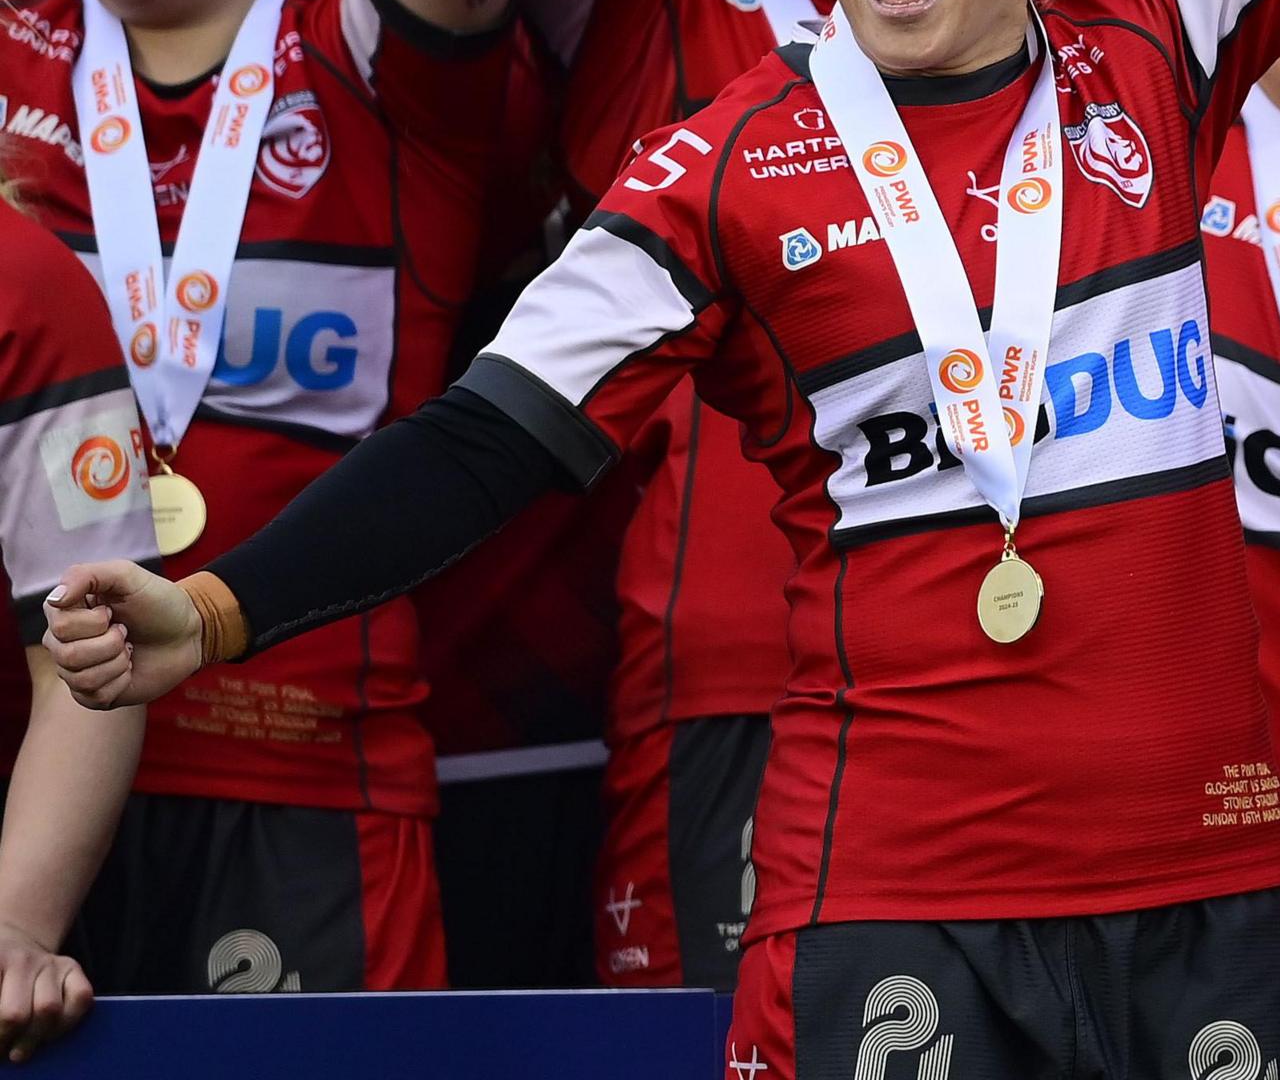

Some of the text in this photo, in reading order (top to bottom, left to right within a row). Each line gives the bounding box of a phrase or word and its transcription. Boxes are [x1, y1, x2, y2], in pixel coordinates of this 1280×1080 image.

[743, 136, 843, 164] HARTP
[1022, 128, 1039, 174] PWR
[750, 152, 850, 180] UNIVER
[890, 180, 920, 224] PWR
[999, 345, 1023, 400] PWR
[963, 399, 989, 453] PWR
[1223, 764, 1241, 778] THE
[1205, 780, 1249, 795] GLOS-HART
[1223, 796, 1254, 810] STONEX
[1203, 812, 1238, 826] SUNDAY
[1241, 811, 1261, 824] 16TH
